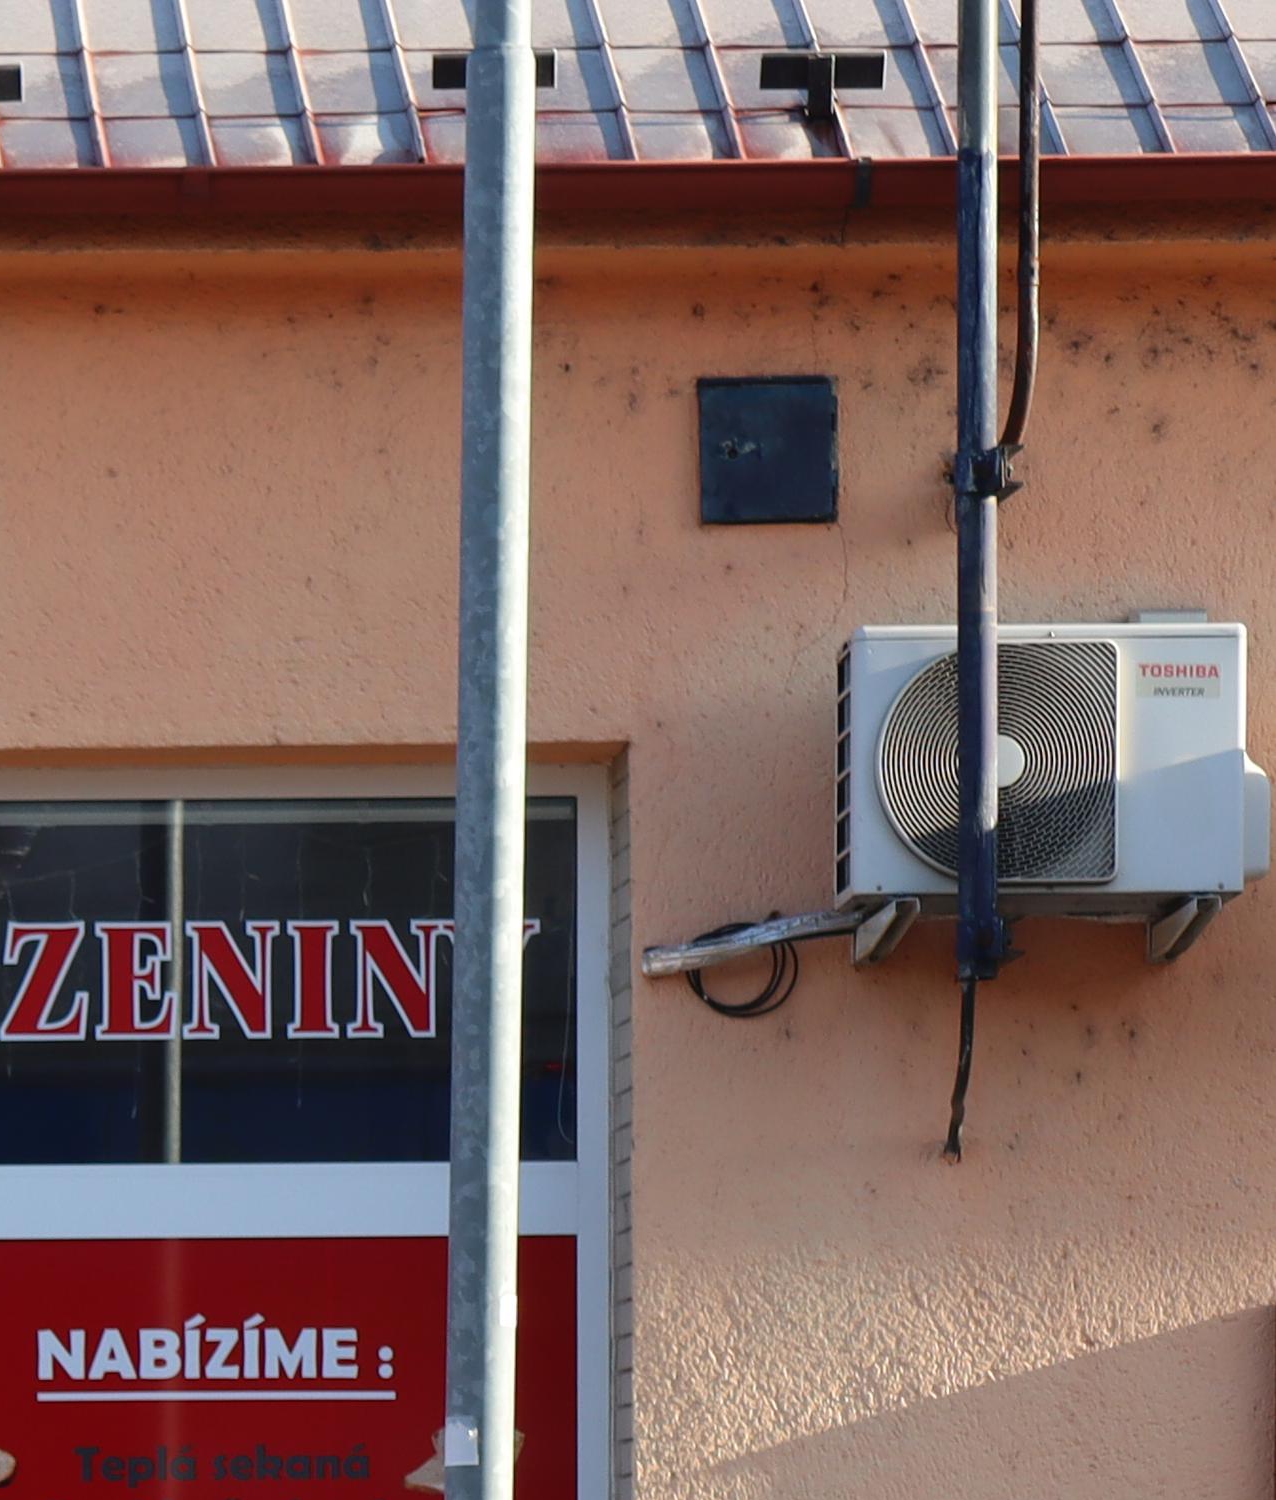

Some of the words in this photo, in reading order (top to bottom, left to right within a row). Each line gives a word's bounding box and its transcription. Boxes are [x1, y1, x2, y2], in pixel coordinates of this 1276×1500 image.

[1138, 664, 1220, 679] TOSHIBA
[1153, 687, 1206, 697] INVERTER
[37, 1313, 358, 1381] NABÍZÍME
[75, 1444, 197, 1488] Teplá
[213, 1444, 371, 1482] sekaná
